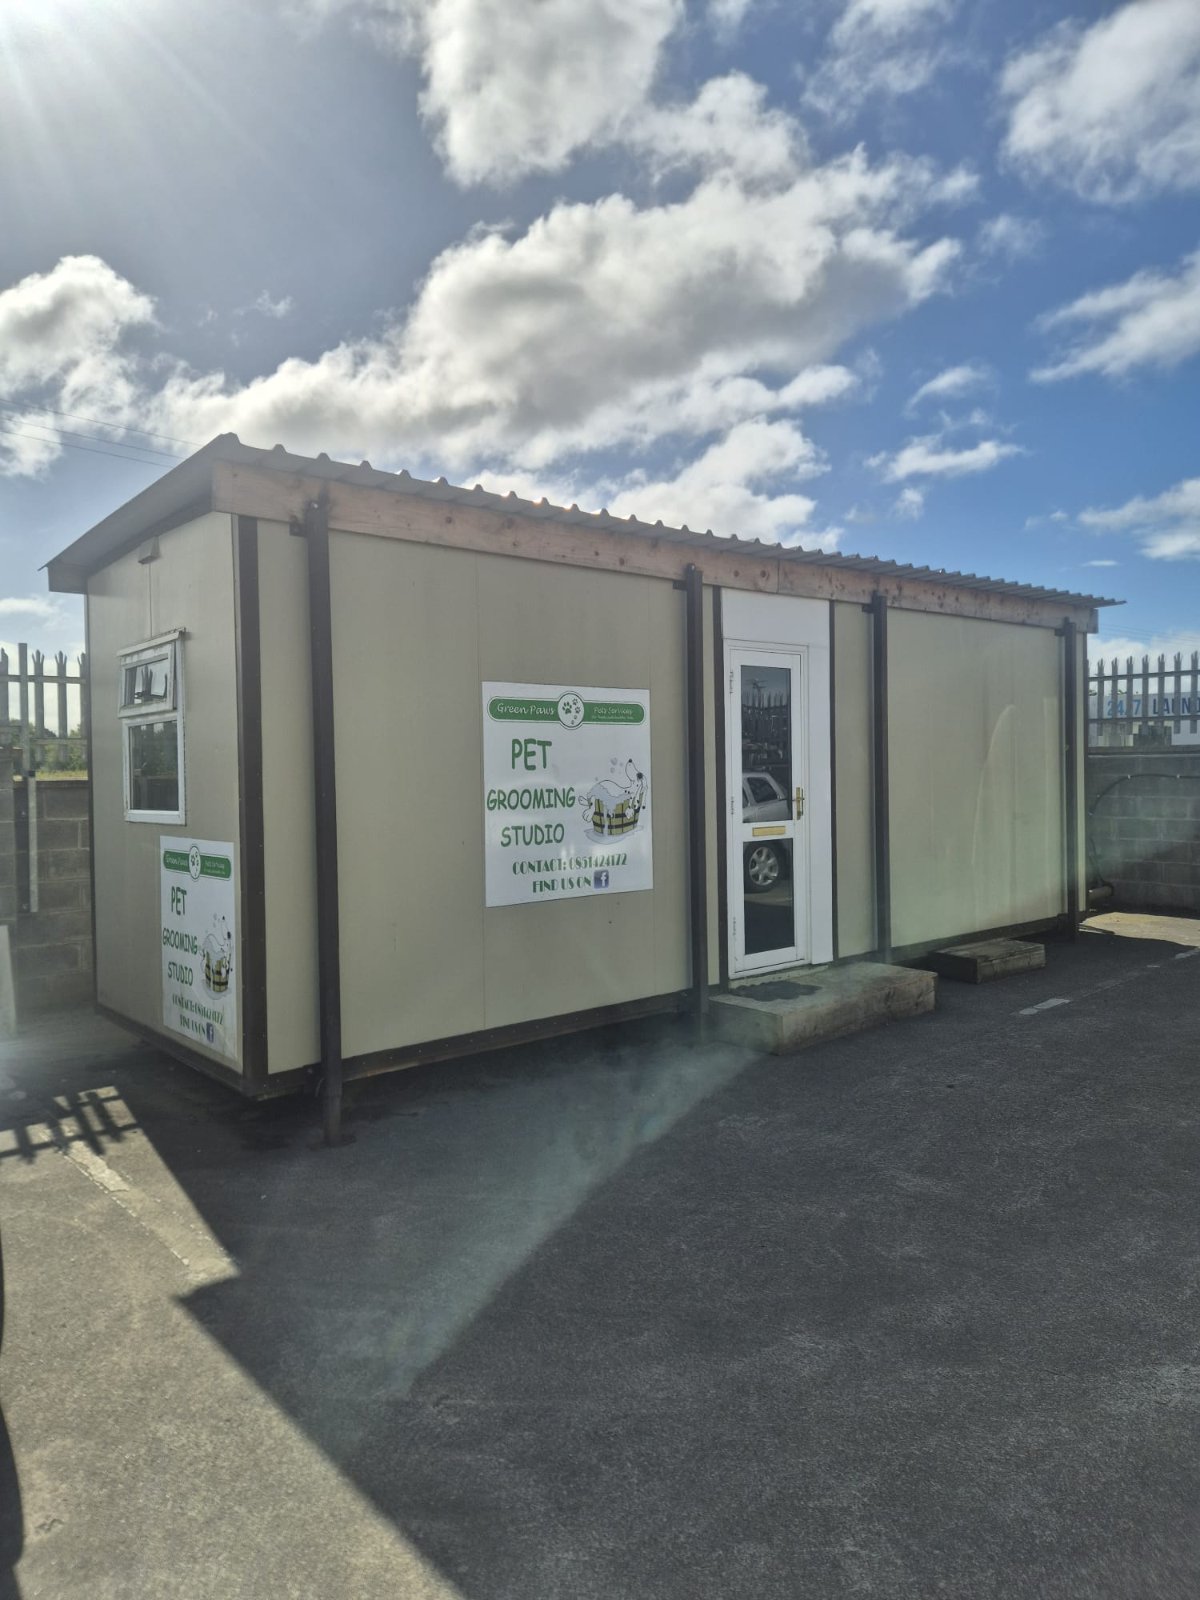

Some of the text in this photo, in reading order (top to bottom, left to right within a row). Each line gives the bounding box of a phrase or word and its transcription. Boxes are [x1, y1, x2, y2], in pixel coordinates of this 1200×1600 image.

[497, 702, 555, 716] Green Paws
[511, 738, 552, 771] PET
[486, 787, 576, 811] GROOMING
[500, 823, 565, 847] STUDIO
[512, 858, 567, 875] CONTACT:
[532, 879, 559, 893] FIND
[561, 877, 575, 890] US
[171, 885, 187, 915] PET
[163, 927, 198, 955] GROOMING
[168, 961, 194, 986] STUDIO
